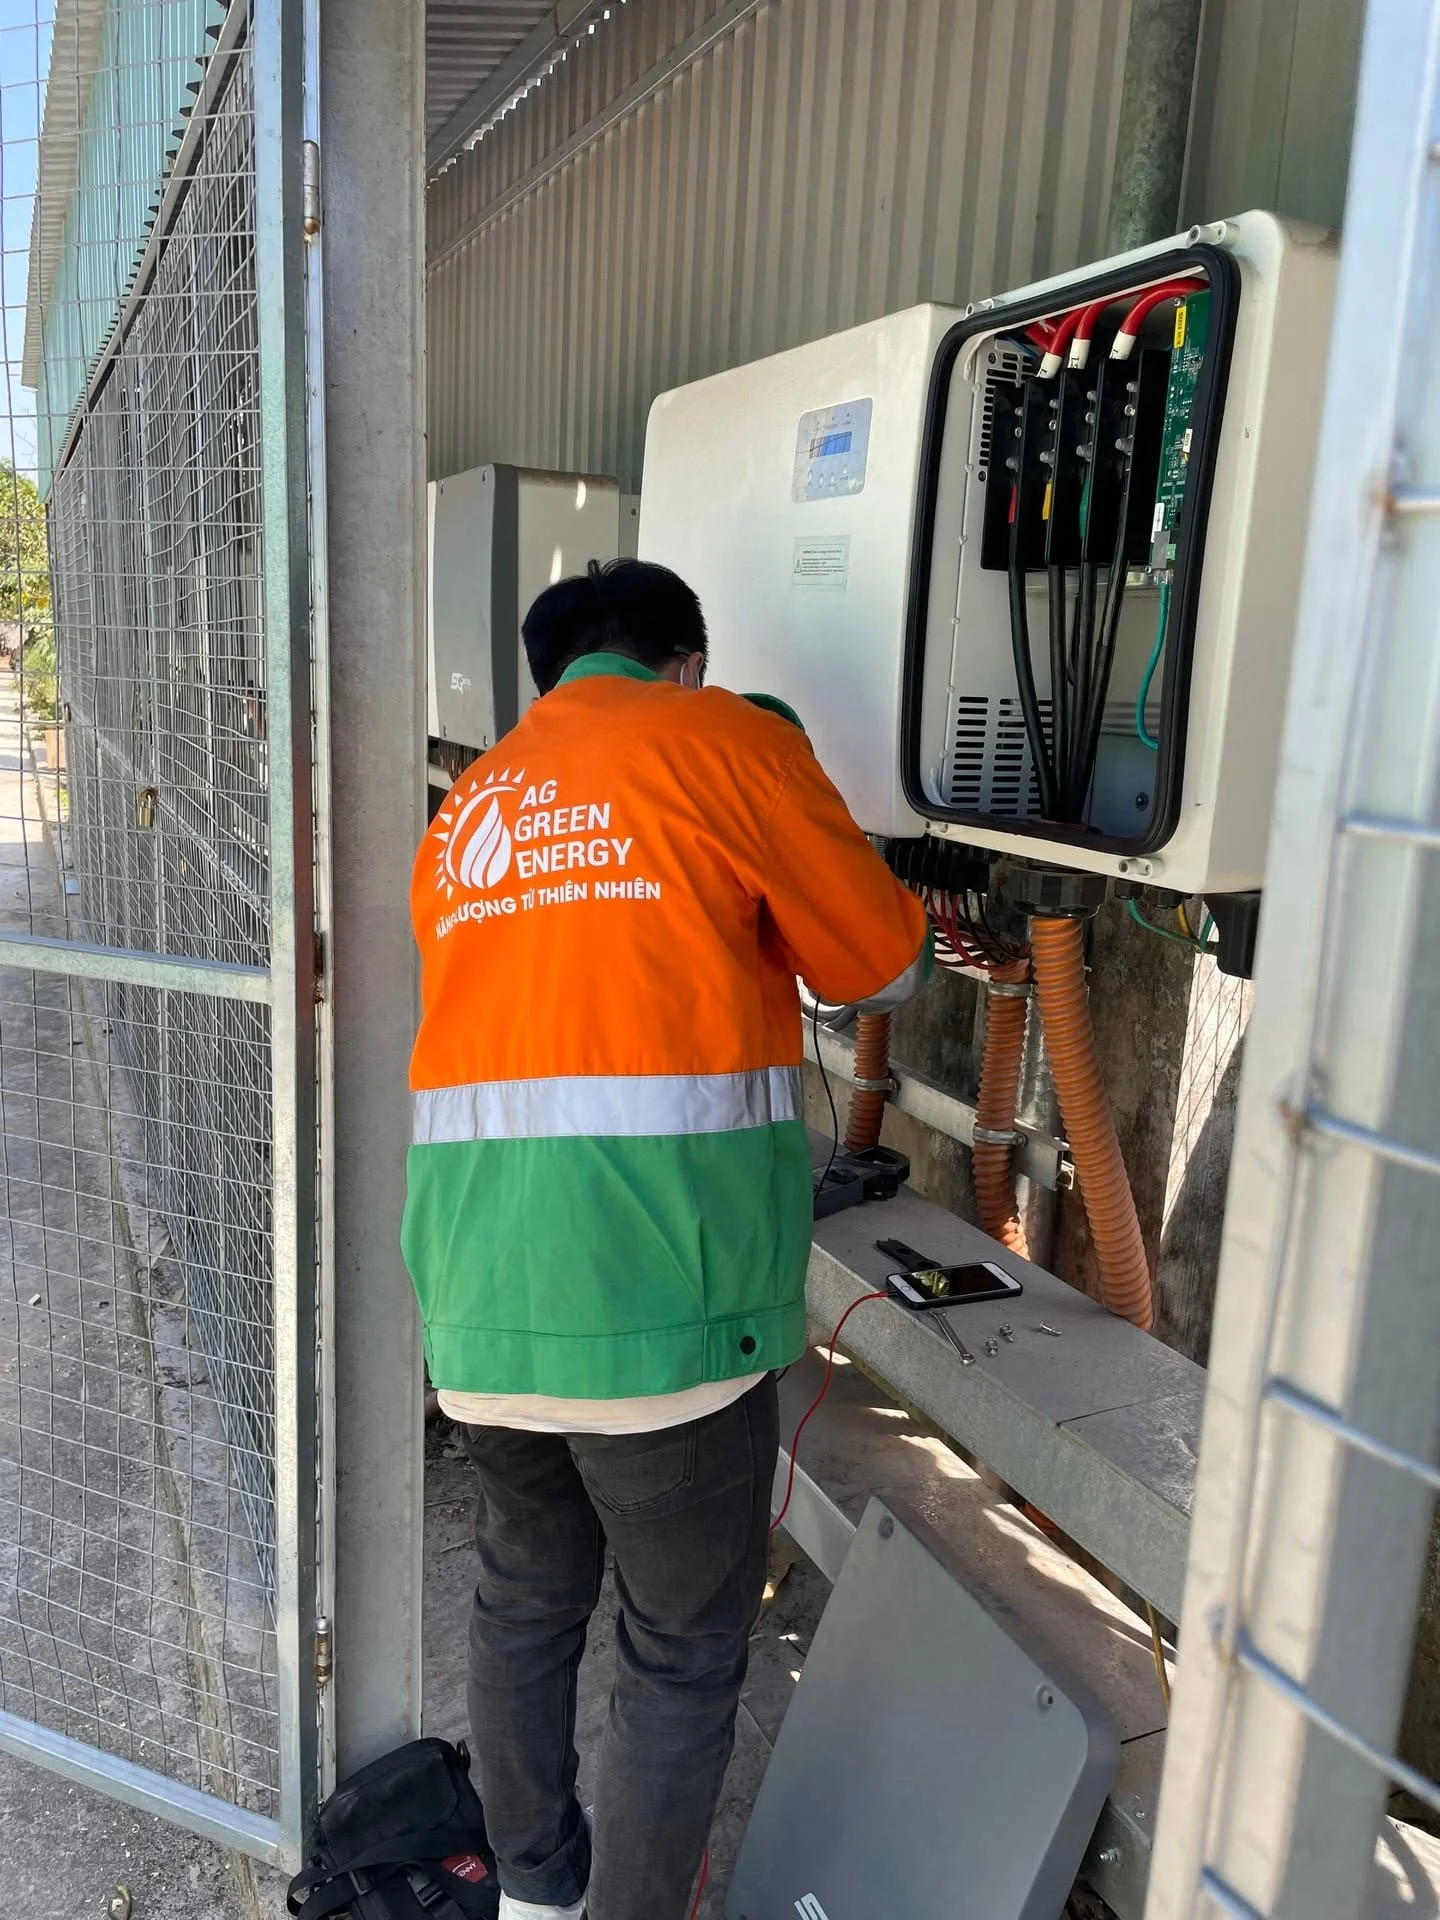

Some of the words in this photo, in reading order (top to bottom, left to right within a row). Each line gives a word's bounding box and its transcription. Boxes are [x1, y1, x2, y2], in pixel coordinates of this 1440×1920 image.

[519, 779, 557, 811] AG
[514, 802, 610, 842] GREEN
[515, 837, 633, 880] ENERGY
[538, 880, 587, 906] THIÊN
[595, 876, 660, 900] NHIÊN
